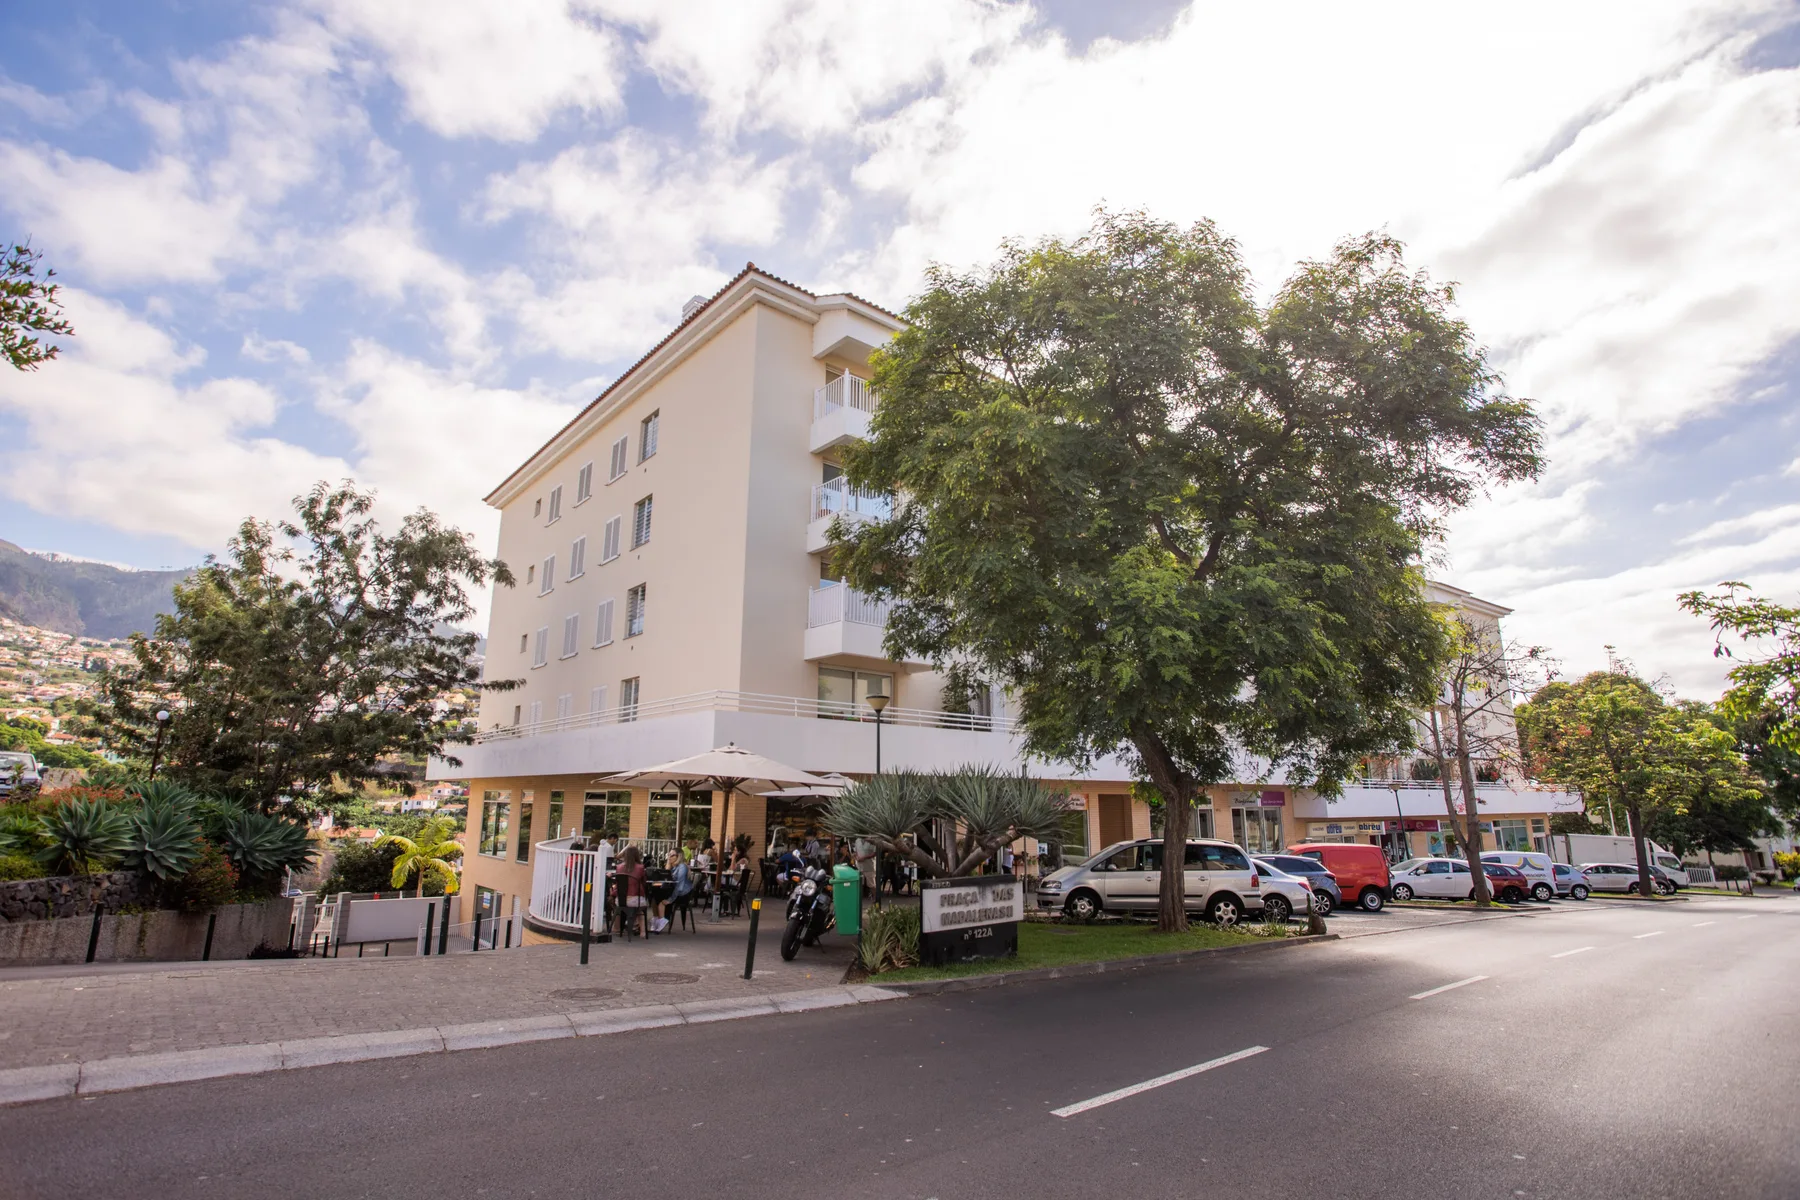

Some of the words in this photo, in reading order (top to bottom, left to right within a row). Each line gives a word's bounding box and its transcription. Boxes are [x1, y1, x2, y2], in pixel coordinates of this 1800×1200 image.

[940, 891, 980, 907] PRAÇA
[993, 887, 1014, 902] DAS
[974, 928, 993, 939] 122A
